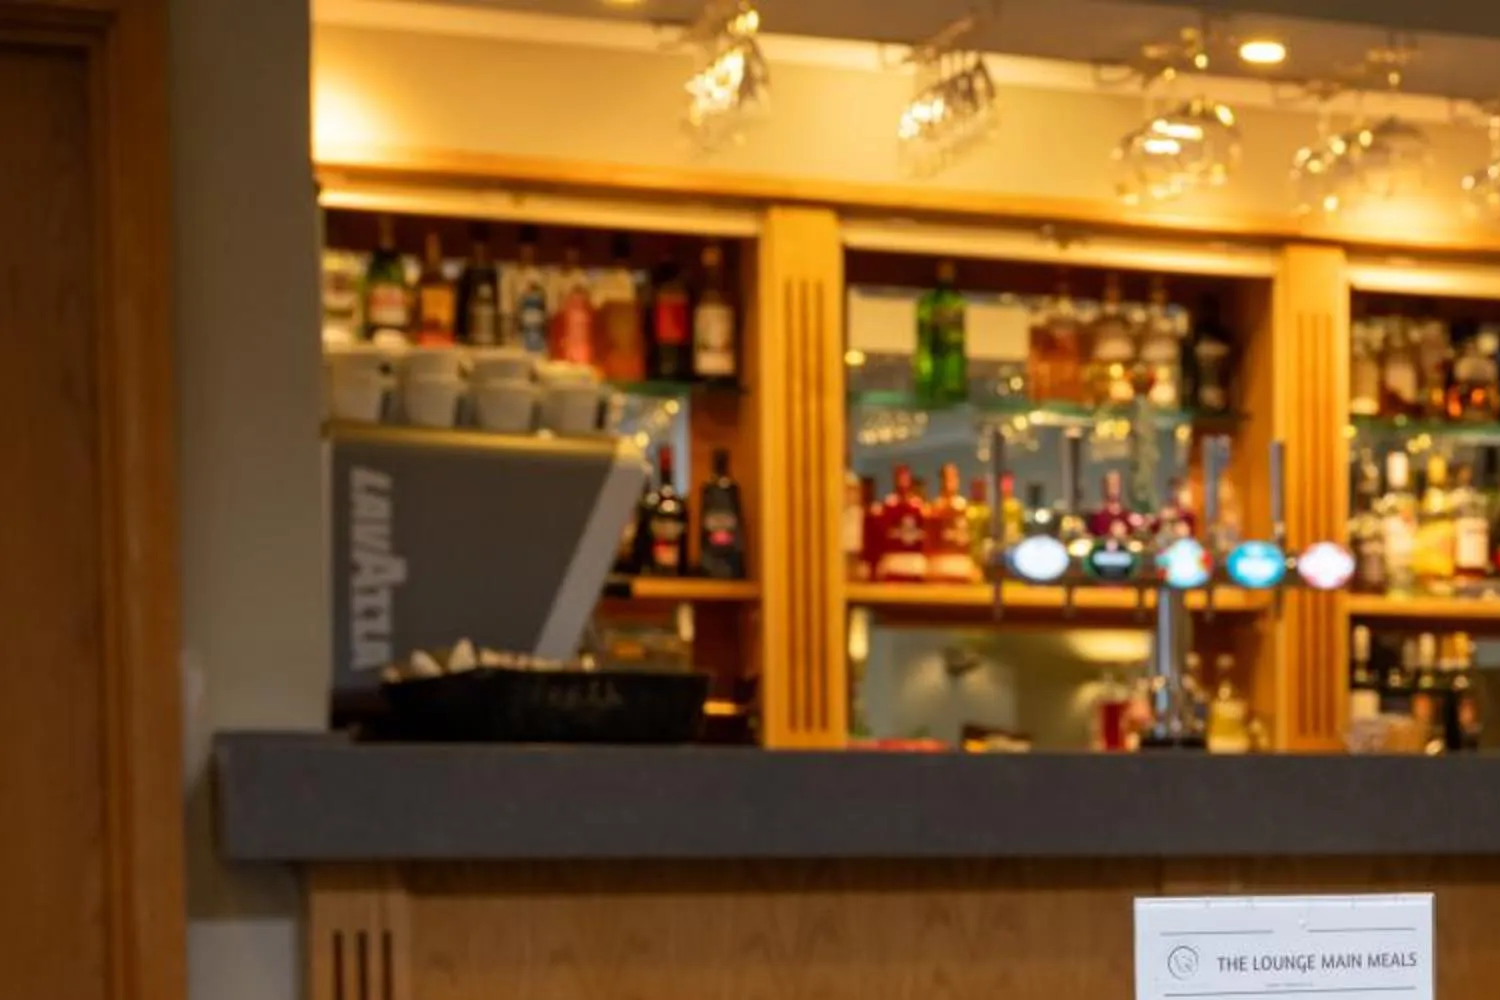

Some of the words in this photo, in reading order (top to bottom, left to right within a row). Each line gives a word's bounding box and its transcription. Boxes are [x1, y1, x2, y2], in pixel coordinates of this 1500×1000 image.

[1216, 955, 1248, 972] THE
[1252, 954, 1315, 974] LOUNGE
[1321, 953, 1363, 969] MAIN
[1367, 951, 1417, 969] MEALS
